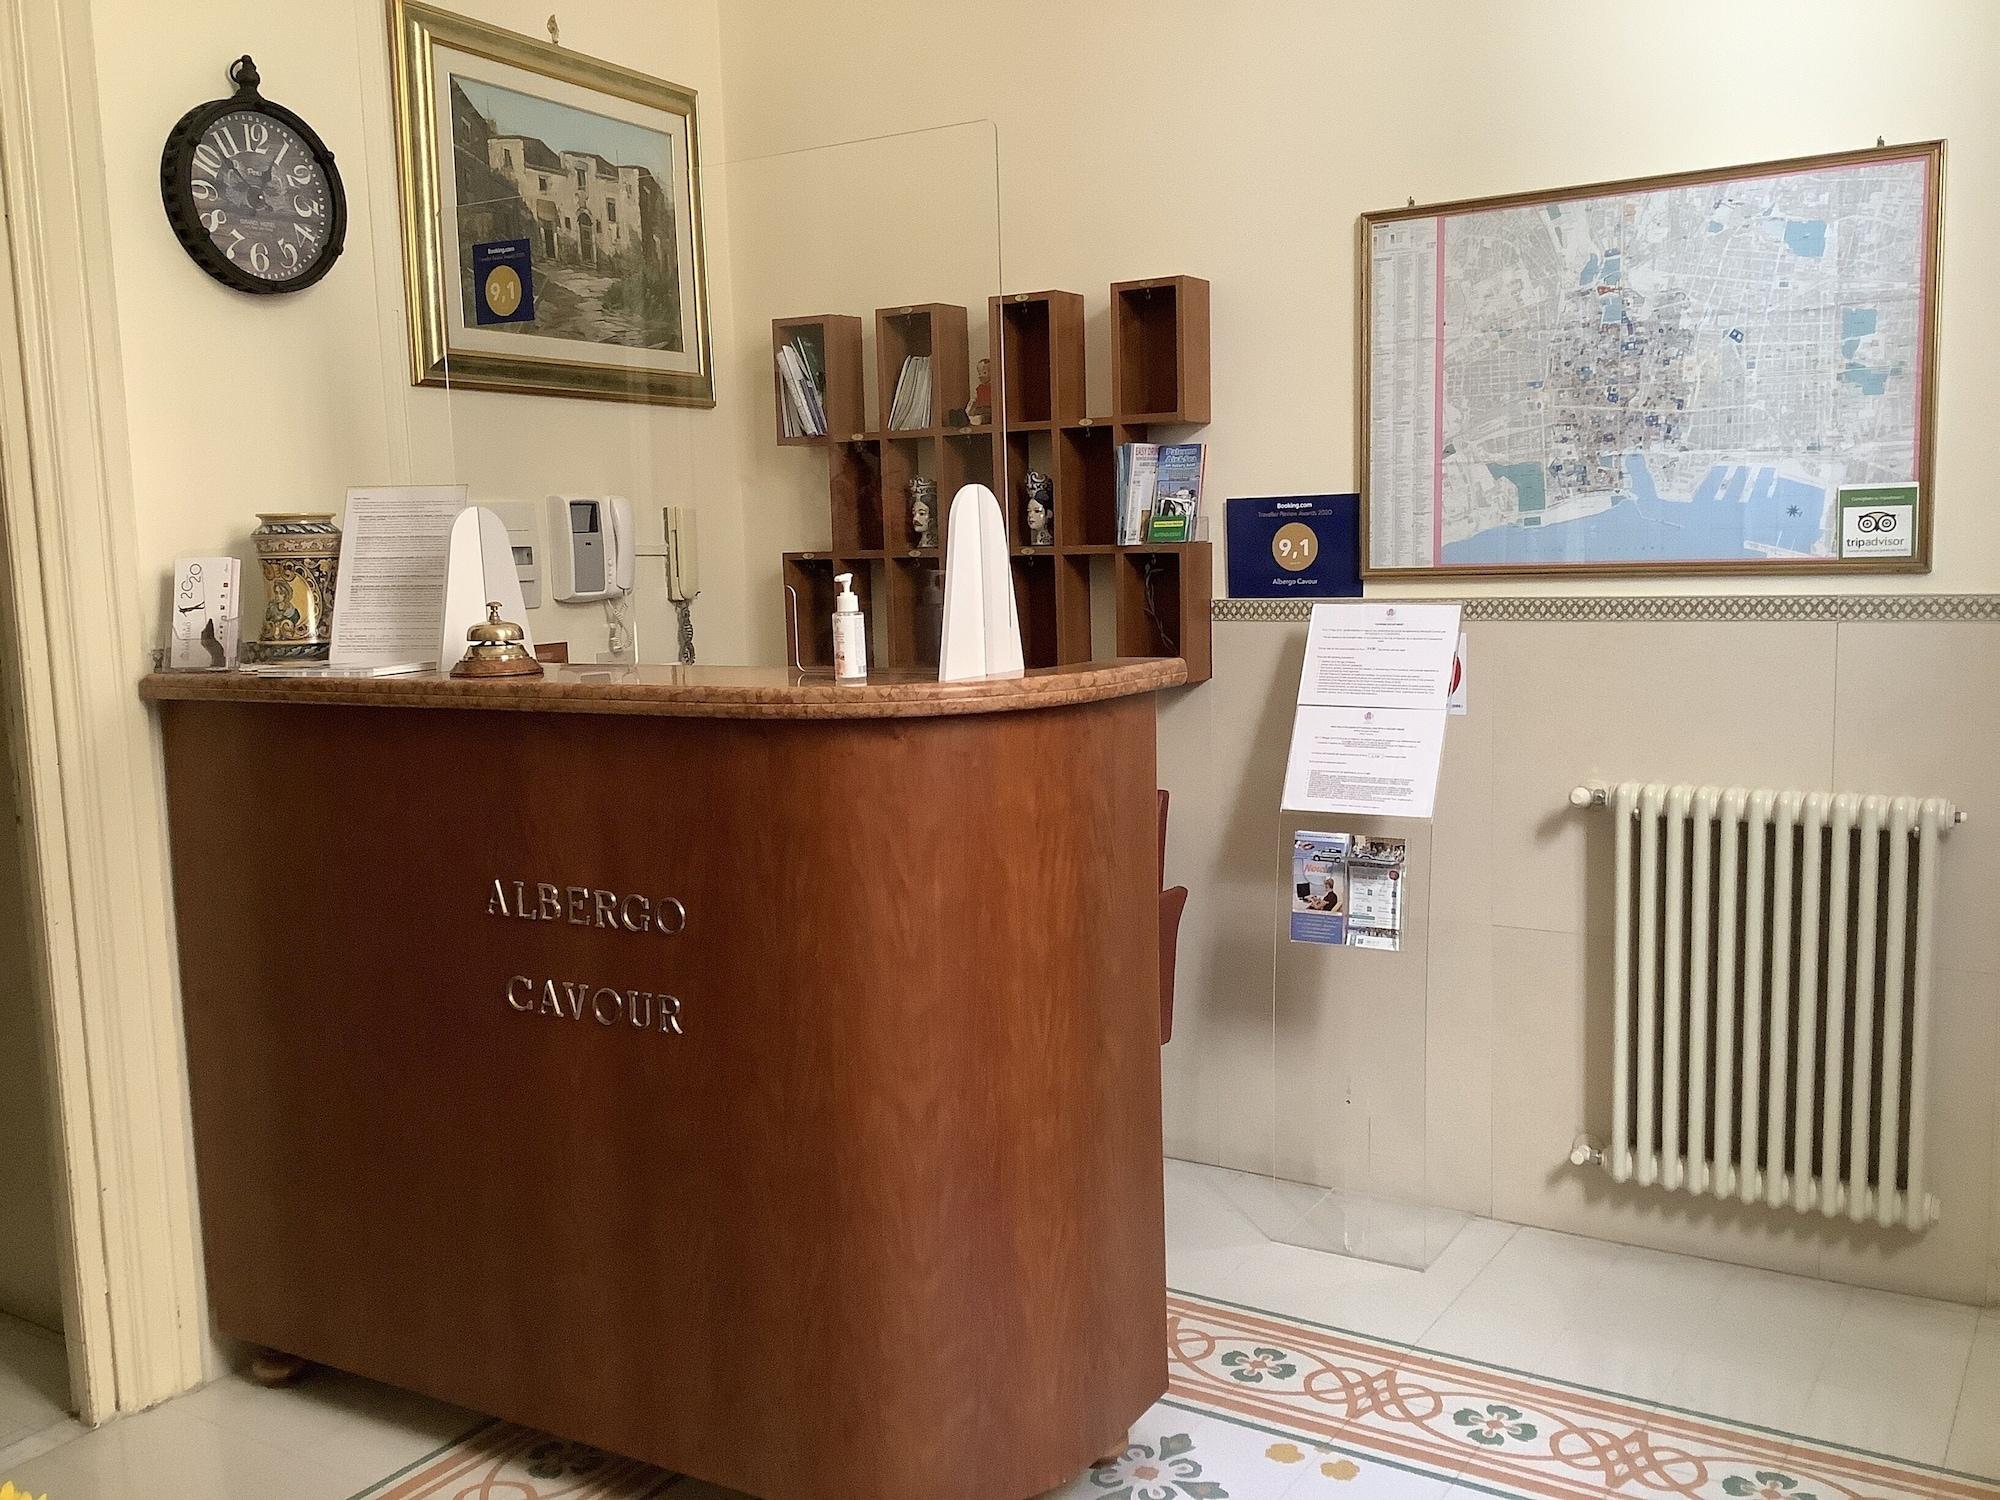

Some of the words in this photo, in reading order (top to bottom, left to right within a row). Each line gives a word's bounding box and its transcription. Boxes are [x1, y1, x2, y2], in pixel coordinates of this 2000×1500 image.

[210, 126, 240, 159] 11
[240, 123, 270, 155] 12
[273, 138, 289, 167] 1
[192, 143, 222, 179] 10
[191, 179, 219, 202] 9
[286, 164, 311, 190] 2
[293, 194, 321, 218] 3
[200, 209, 227, 233] 8
[226, 229, 246, 260] 7
[293, 222, 316, 248] 4
[250, 242, 270, 272] 6
[277, 238, 298, 269] 5
[490, 281, 515, 304] 9,1
[1278, 538, 1309, 559] 9,1
[1846, 537, 1905, 549] tripadvisor
[1272, 578, 1296, 586] Albergo
[487, 878, 687, 935] ALBERGO
[507, 974, 686, 1035] CAVOUR
